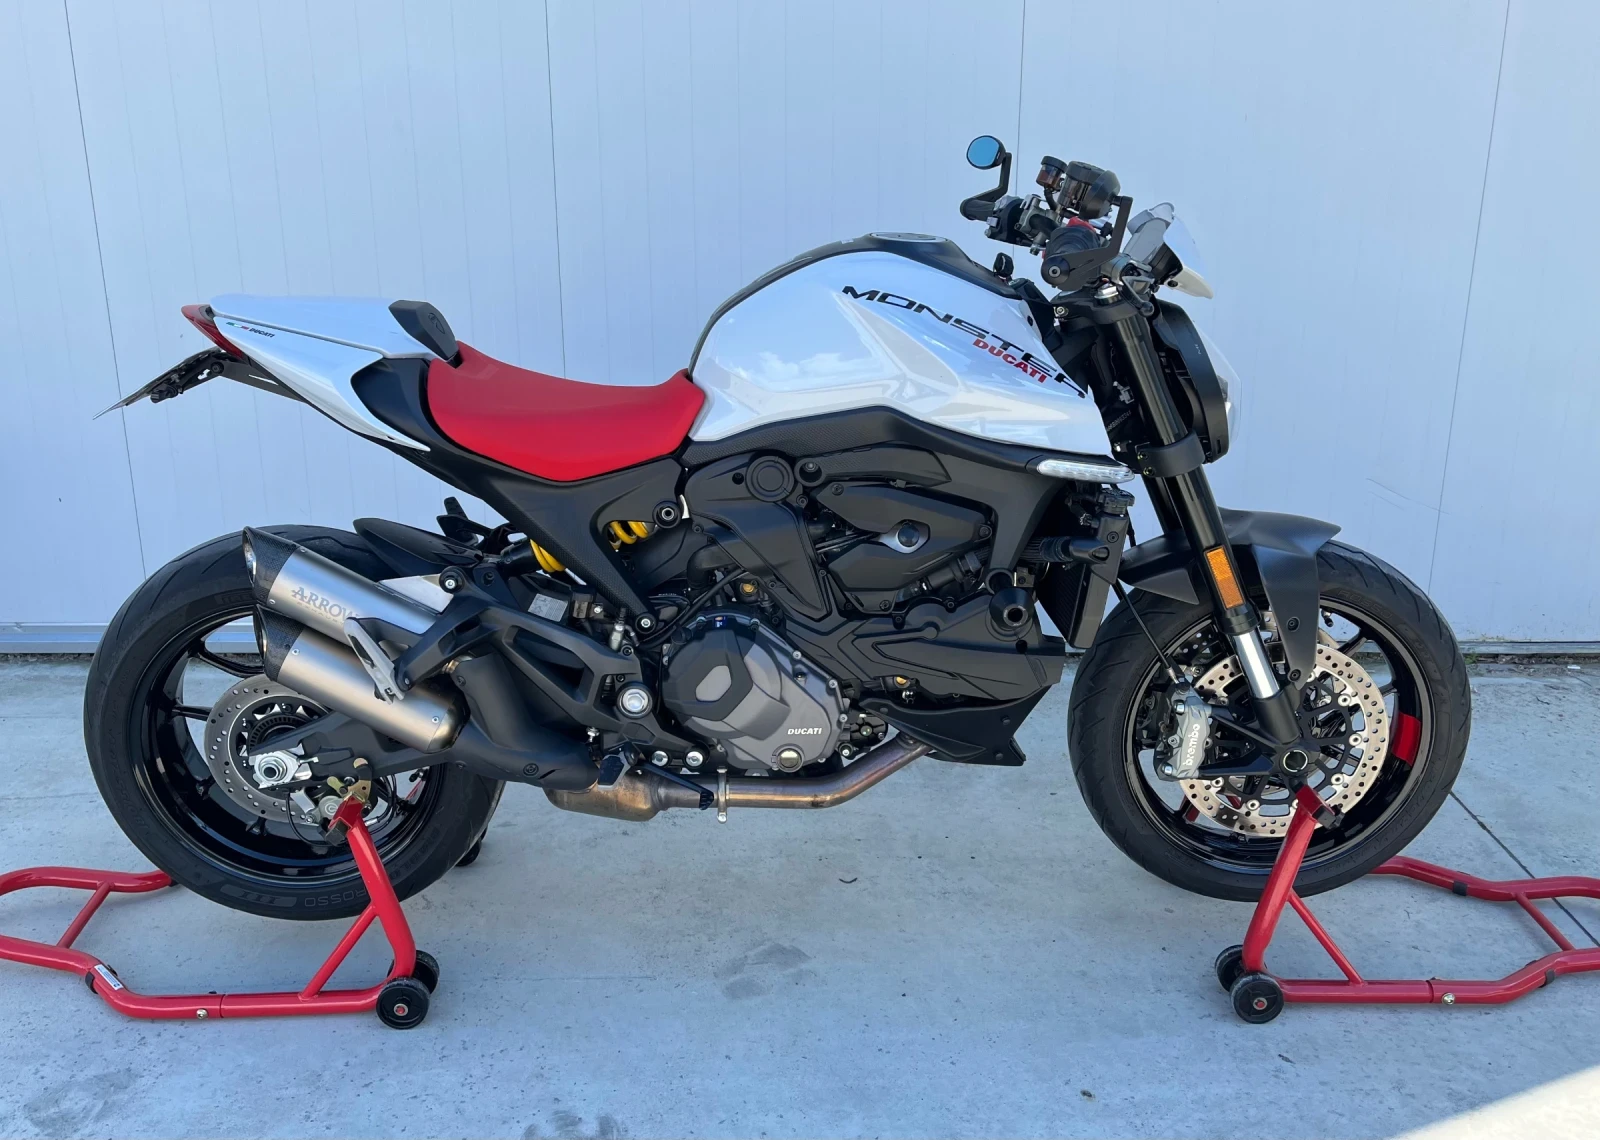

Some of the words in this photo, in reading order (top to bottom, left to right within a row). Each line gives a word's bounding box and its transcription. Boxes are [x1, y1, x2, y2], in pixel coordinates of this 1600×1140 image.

[248, 327, 275, 338] DUCATI
[841, 285, 1086, 398] MONSTER
[972, 338, 1048, 384] DUCATI
[787, 727, 822, 735] DUCATI
[1182, 722, 1201, 767] brembo
